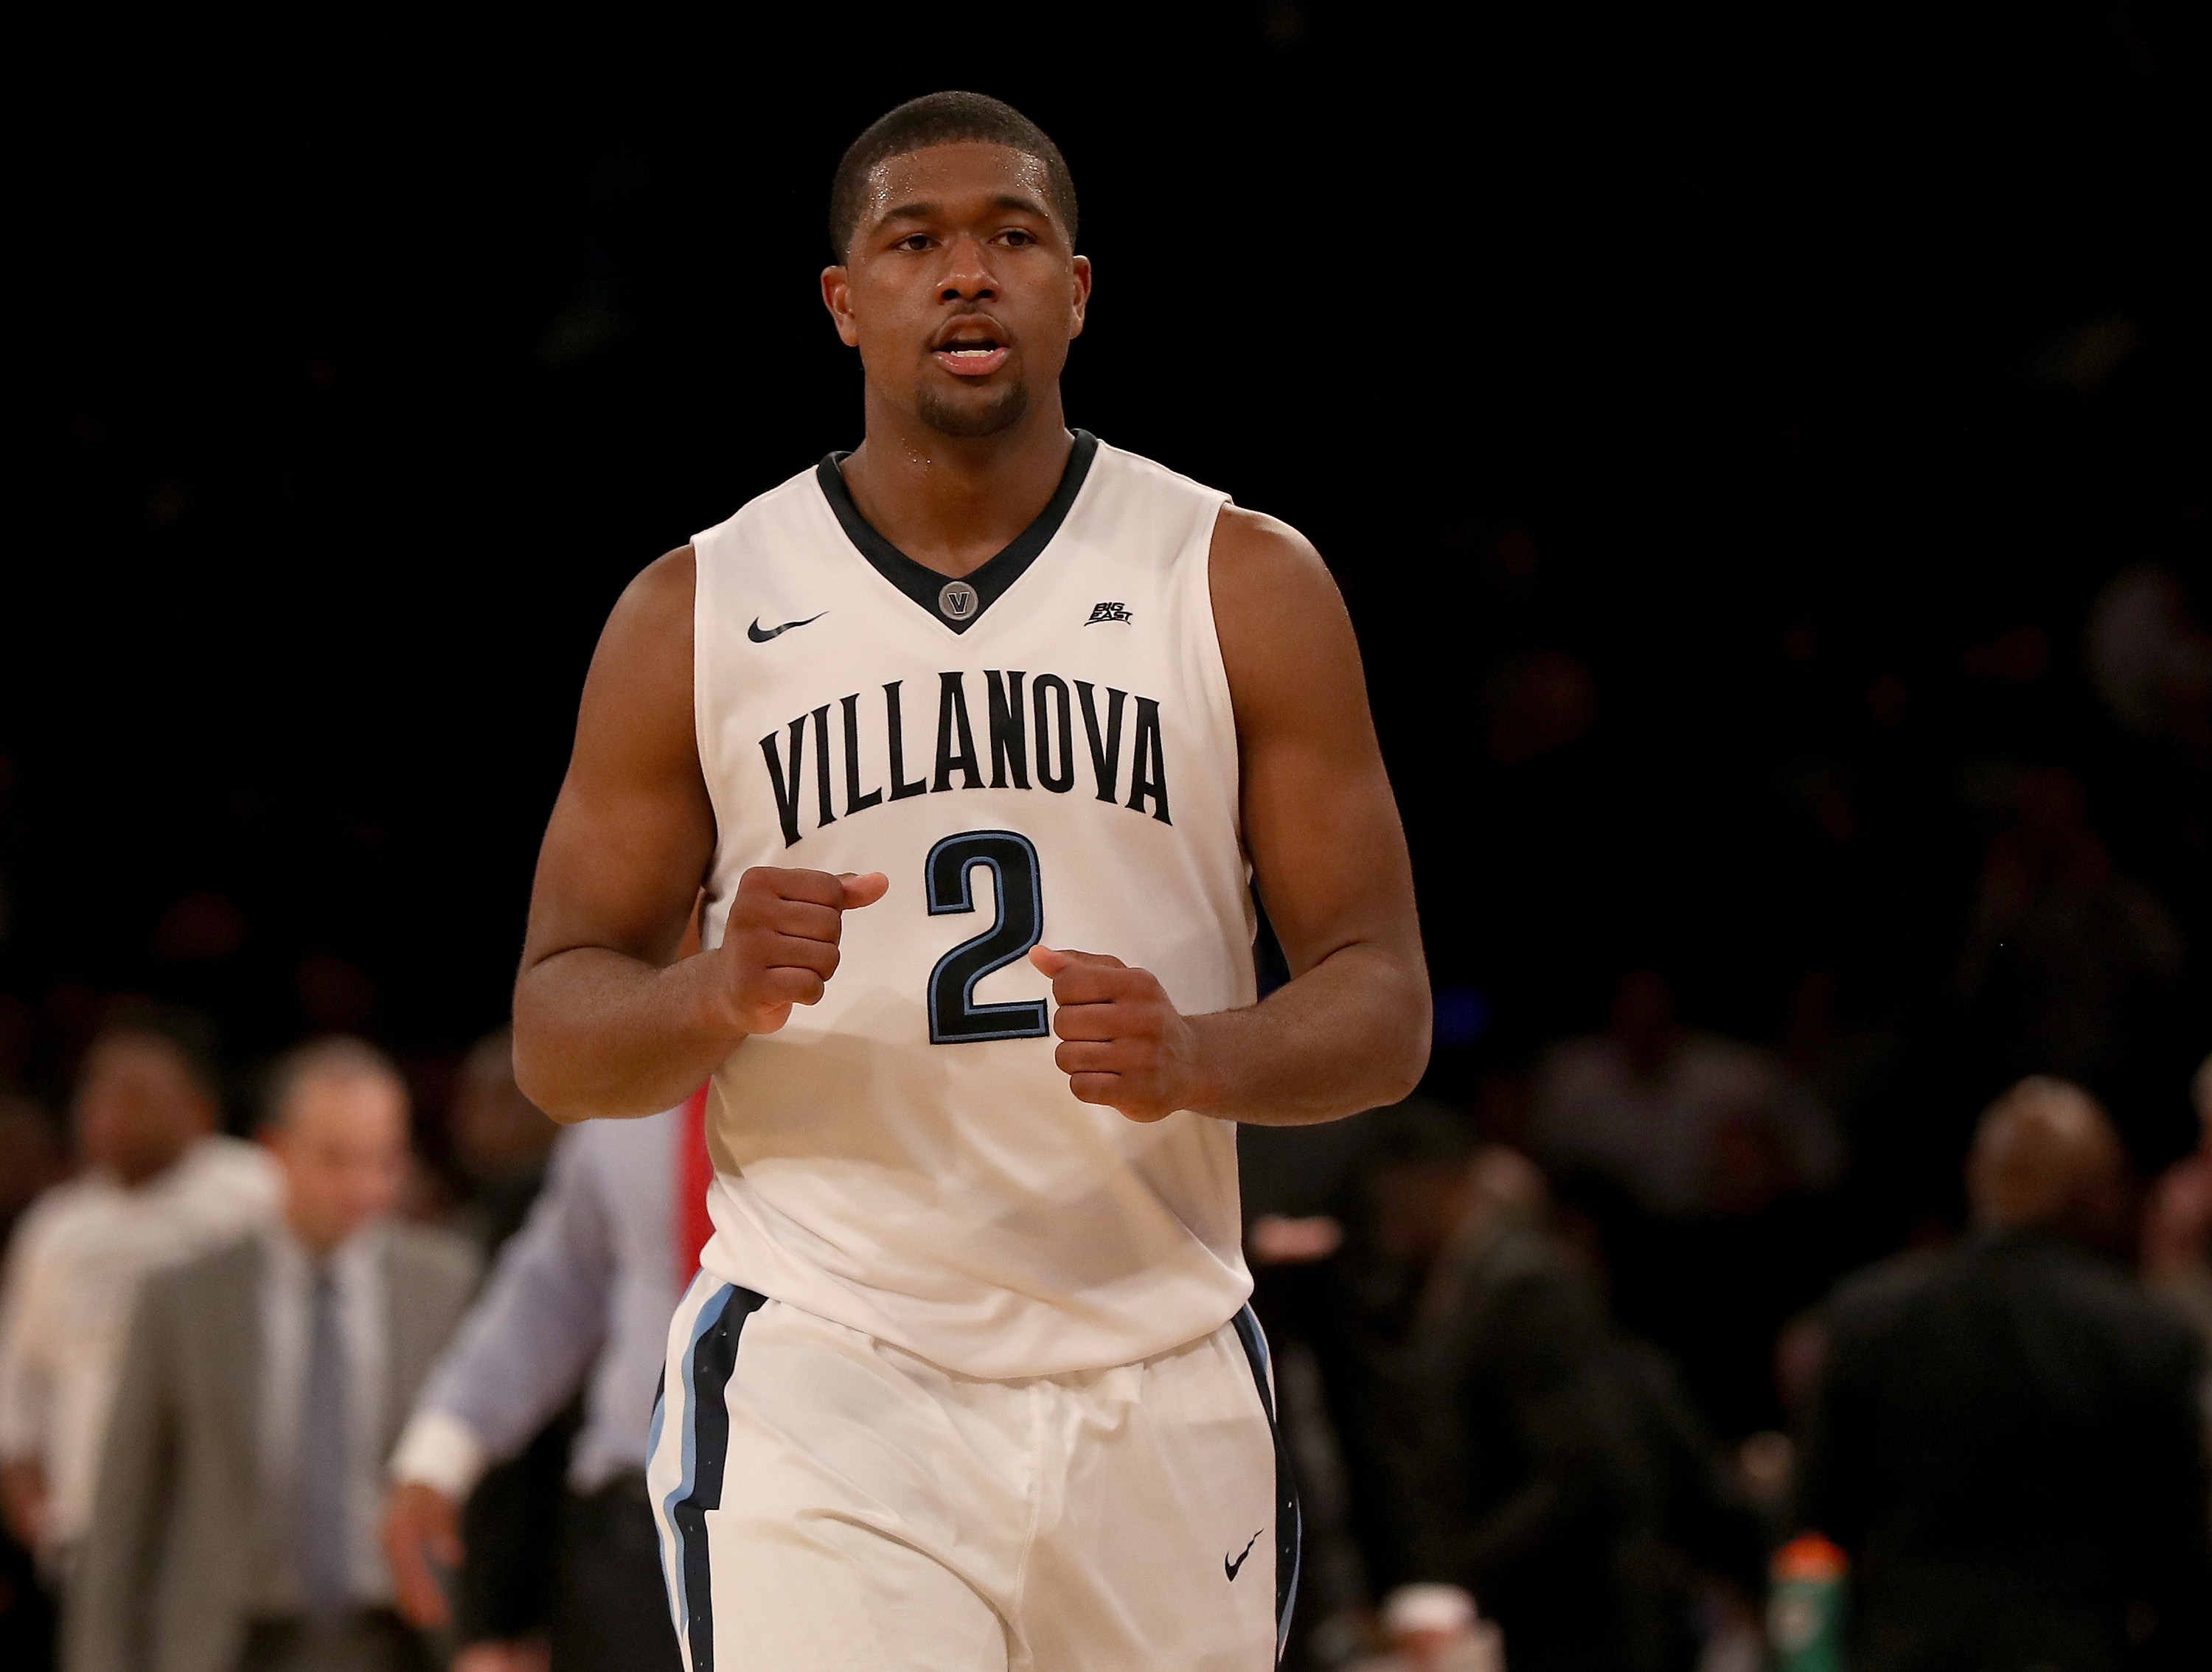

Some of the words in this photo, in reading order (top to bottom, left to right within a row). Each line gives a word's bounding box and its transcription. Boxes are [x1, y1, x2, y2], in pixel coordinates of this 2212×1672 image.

[947, 592, 970, 614] V
[1094, 602, 1124, 611] BIG
[1089, 610, 1133, 621] EAST
[759, 670, 1172, 849] VILLANOVA
[925, 830, 1049, 1045] 2
